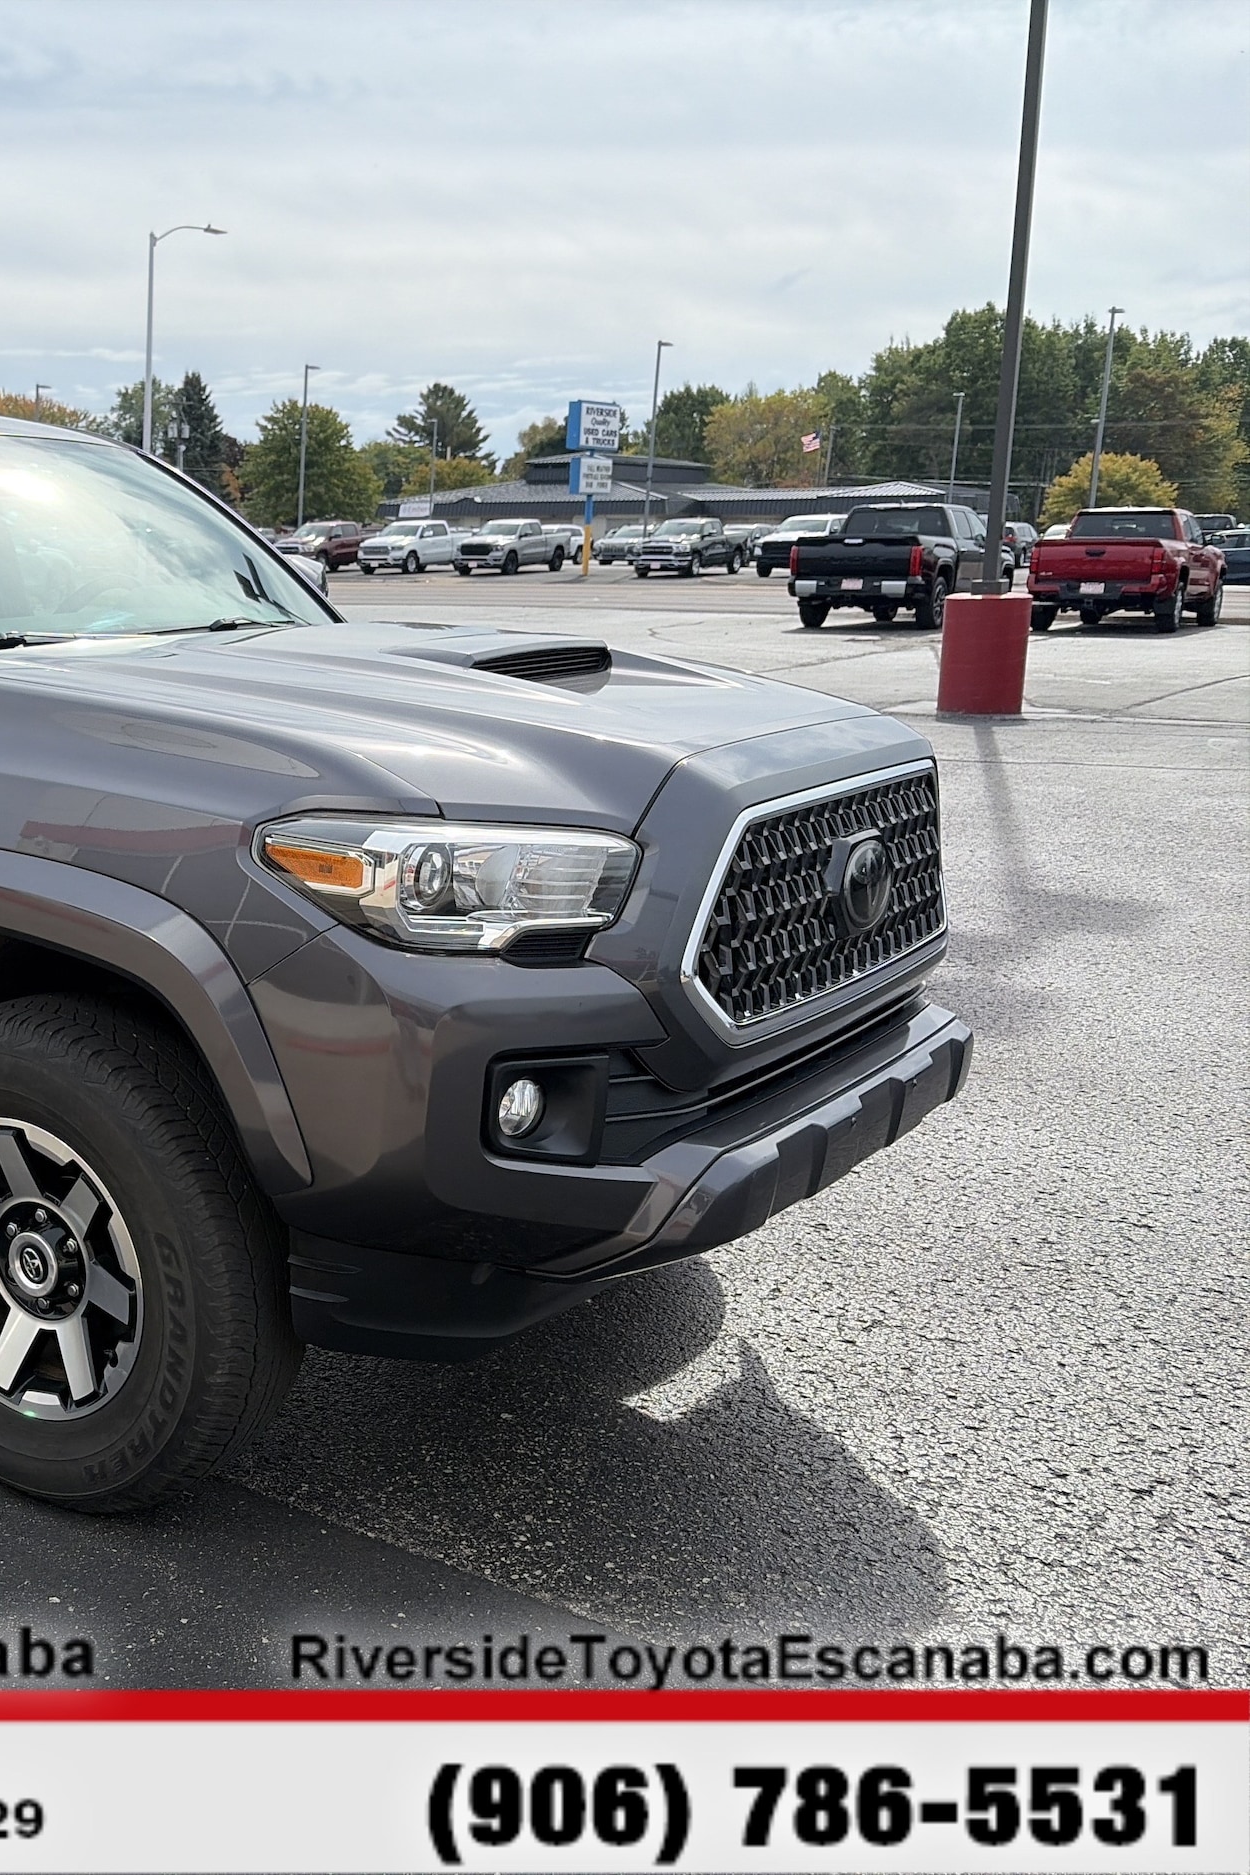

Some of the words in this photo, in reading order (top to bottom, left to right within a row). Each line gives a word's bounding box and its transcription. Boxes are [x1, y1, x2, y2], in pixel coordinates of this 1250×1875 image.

[586, 406, 617, 418] RIVERSIDE
[591, 418, 611, 427] Quality
[583, 428, 599, 436] USED
[601, 429, 617, 438] CARS
[592, 438, 615, 447] TRUCKS
